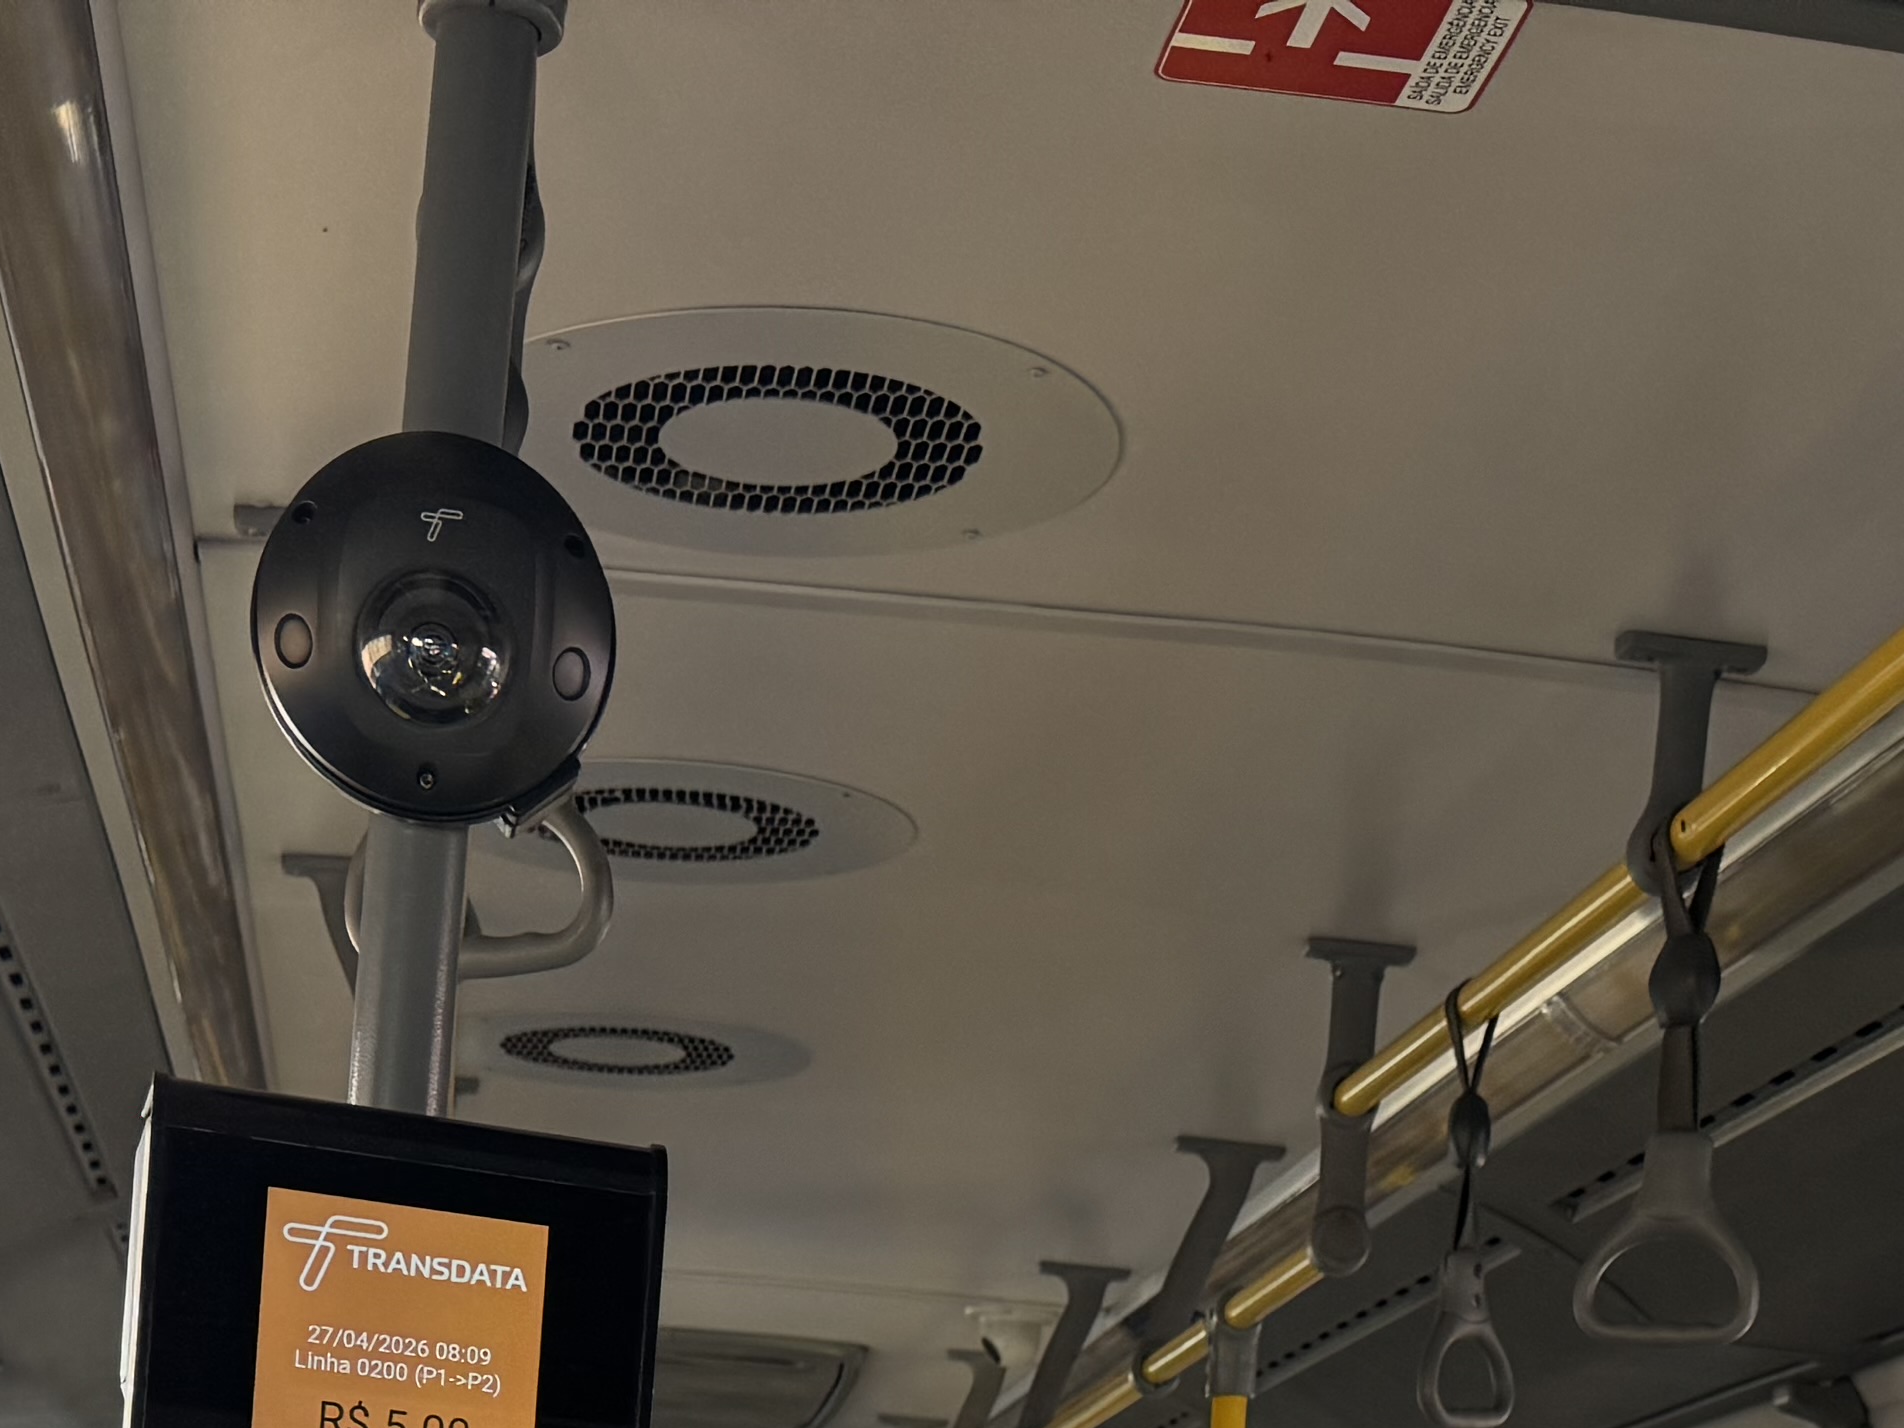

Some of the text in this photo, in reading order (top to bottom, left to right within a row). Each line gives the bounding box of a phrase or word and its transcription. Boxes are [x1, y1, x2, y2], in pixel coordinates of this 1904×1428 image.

[1423, 62, 1443, 75] DE
[1444, 61, 1464, 75] DE
[1453, 16, 1512, 95] EMERGENCY EXIT
[346, 1244, 528, 1292] TRANSDATA
[307, 1325, 492, 1366] 27/04/2026 08:09
[294, 1349, 501, 1398] Linha 0200 (P1->P2)
